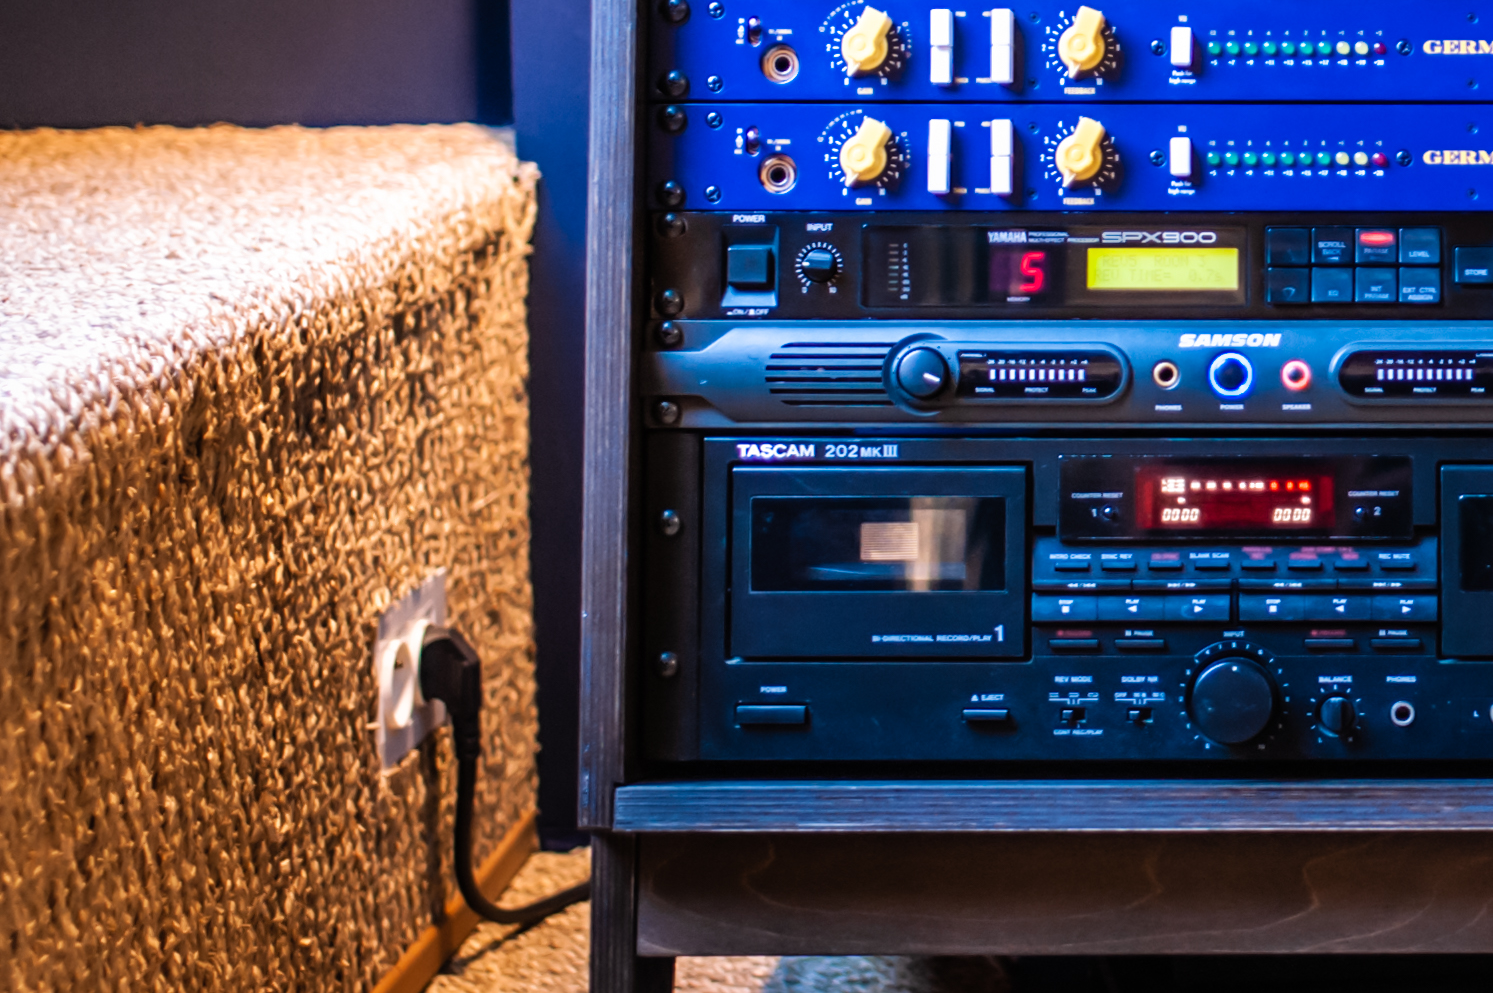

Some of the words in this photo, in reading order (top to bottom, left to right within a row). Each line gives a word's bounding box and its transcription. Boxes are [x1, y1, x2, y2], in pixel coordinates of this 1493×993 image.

[733, 215, 765, 223] POWER
[807, 223, 833, 231] INPUT
[987, 232, 1027, 244] YAMAHA
[1102, 232, 1216, 243] SPX900
[1178, 333, 1282, 347] SAMSON
[737, 444, 815, 457] TASCAM
[825, 444, 858, 457] 202
[1092, 508, 1098, 517] 1
[1374, 507, 1381, 516] 2
[872, 634, 934, 642] BI-DIRECTIONAL
[936, 634, 992, 642] RECORD/PLAY
[994, 625, 1004, 642] 1
